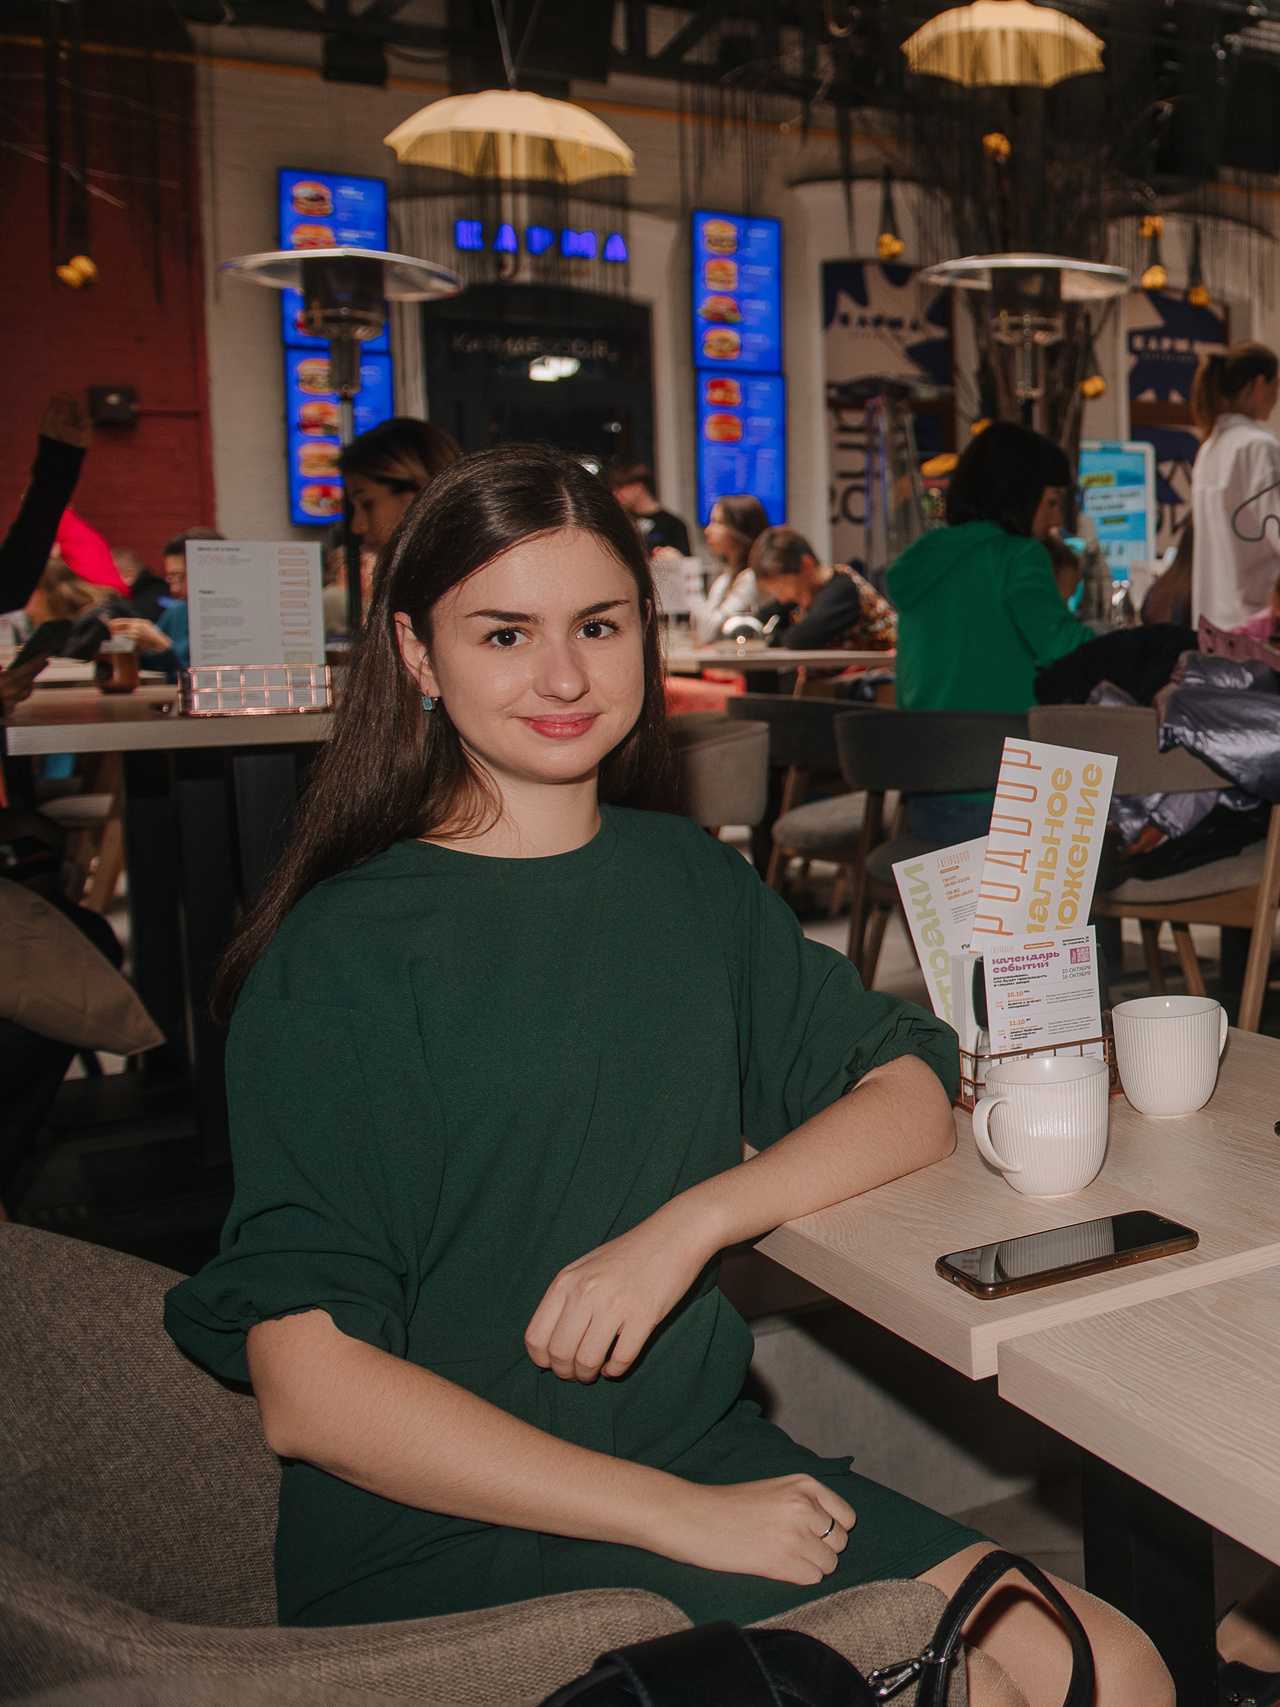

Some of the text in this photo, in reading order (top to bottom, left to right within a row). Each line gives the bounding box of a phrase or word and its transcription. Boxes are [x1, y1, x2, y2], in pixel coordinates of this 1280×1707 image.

[1055, 763, 1103, 931] ожение
[992, 951, 1060, 965] календарь
[992, 960, 1049, 974] событий
[1069, 965, 1091, 974] ОКТЯБРЯ
[1069, 971, 1091, 979] ОКТЯБРЯ
[1009, 1019, 1026, 1027] 11.10
